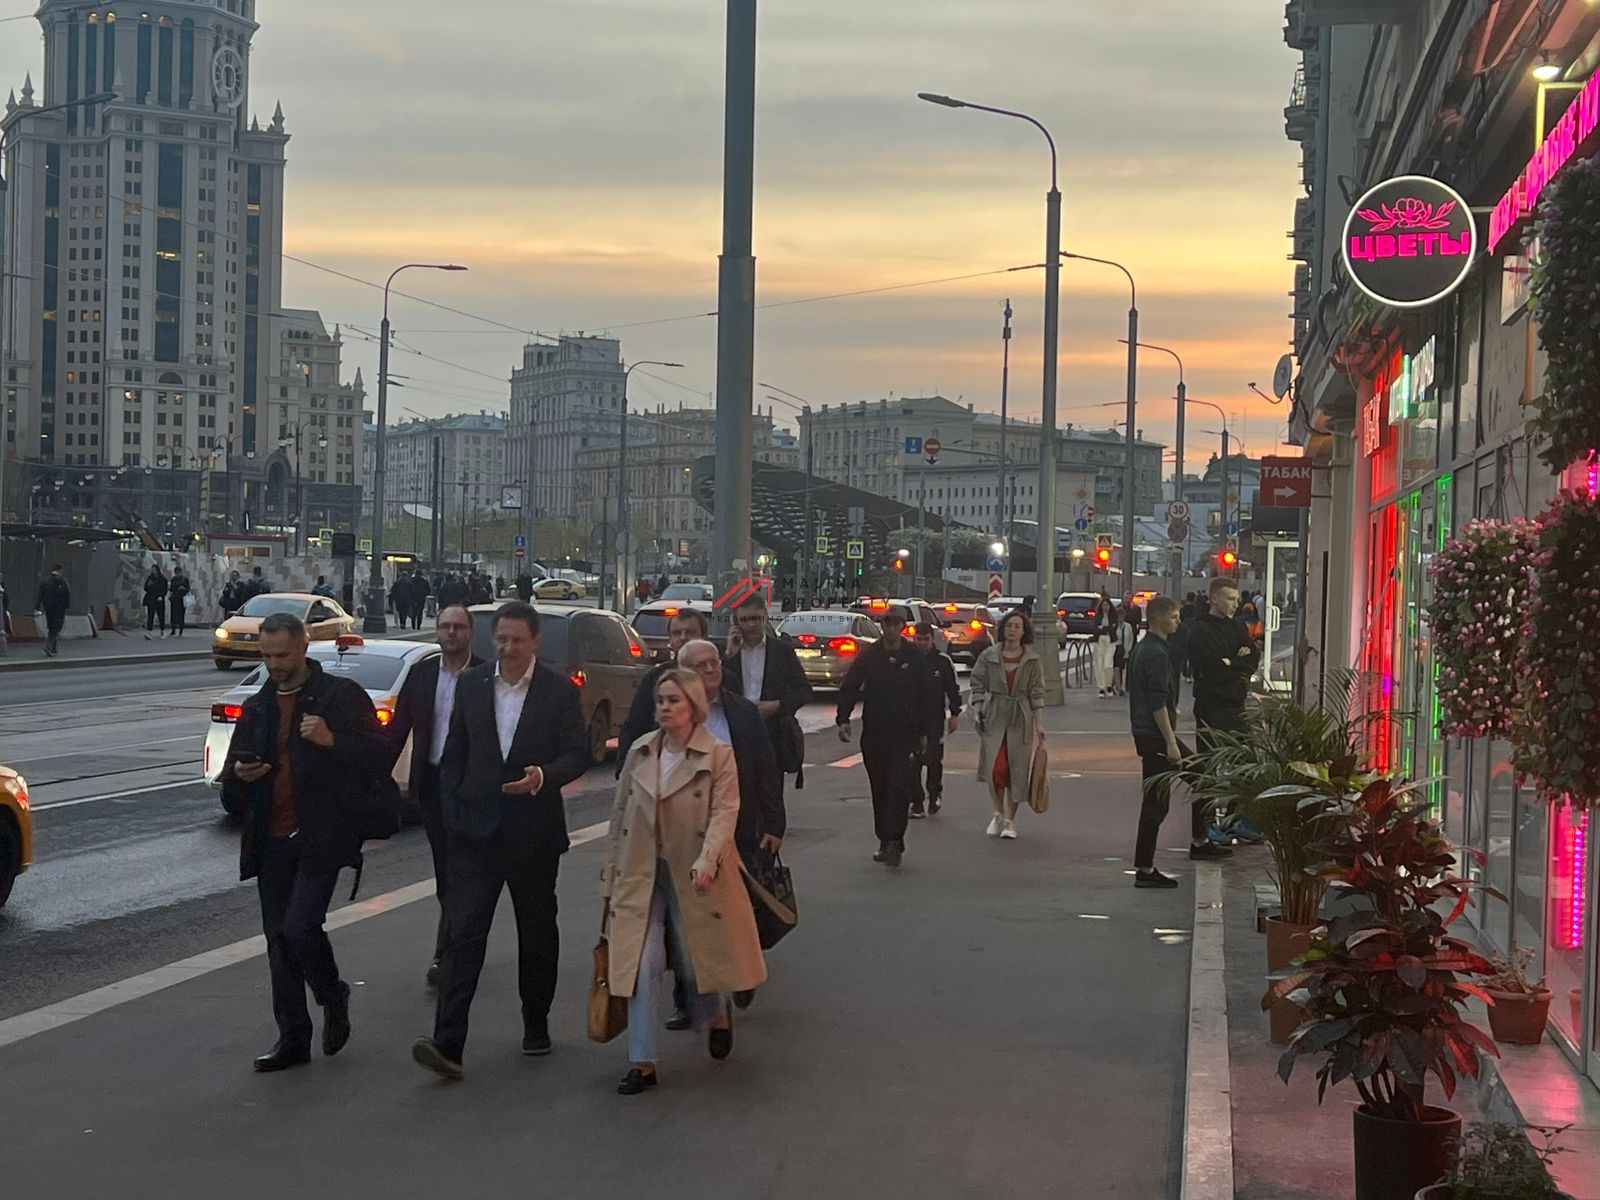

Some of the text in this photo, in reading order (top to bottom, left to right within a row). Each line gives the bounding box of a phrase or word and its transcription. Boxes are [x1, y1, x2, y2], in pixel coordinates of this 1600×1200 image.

[1351, 231, 1470, 262] ЦВЕТЫ
[1261, 465, 1311, 479] ТАБАК
[1172, 504, 1185, 515] 30
